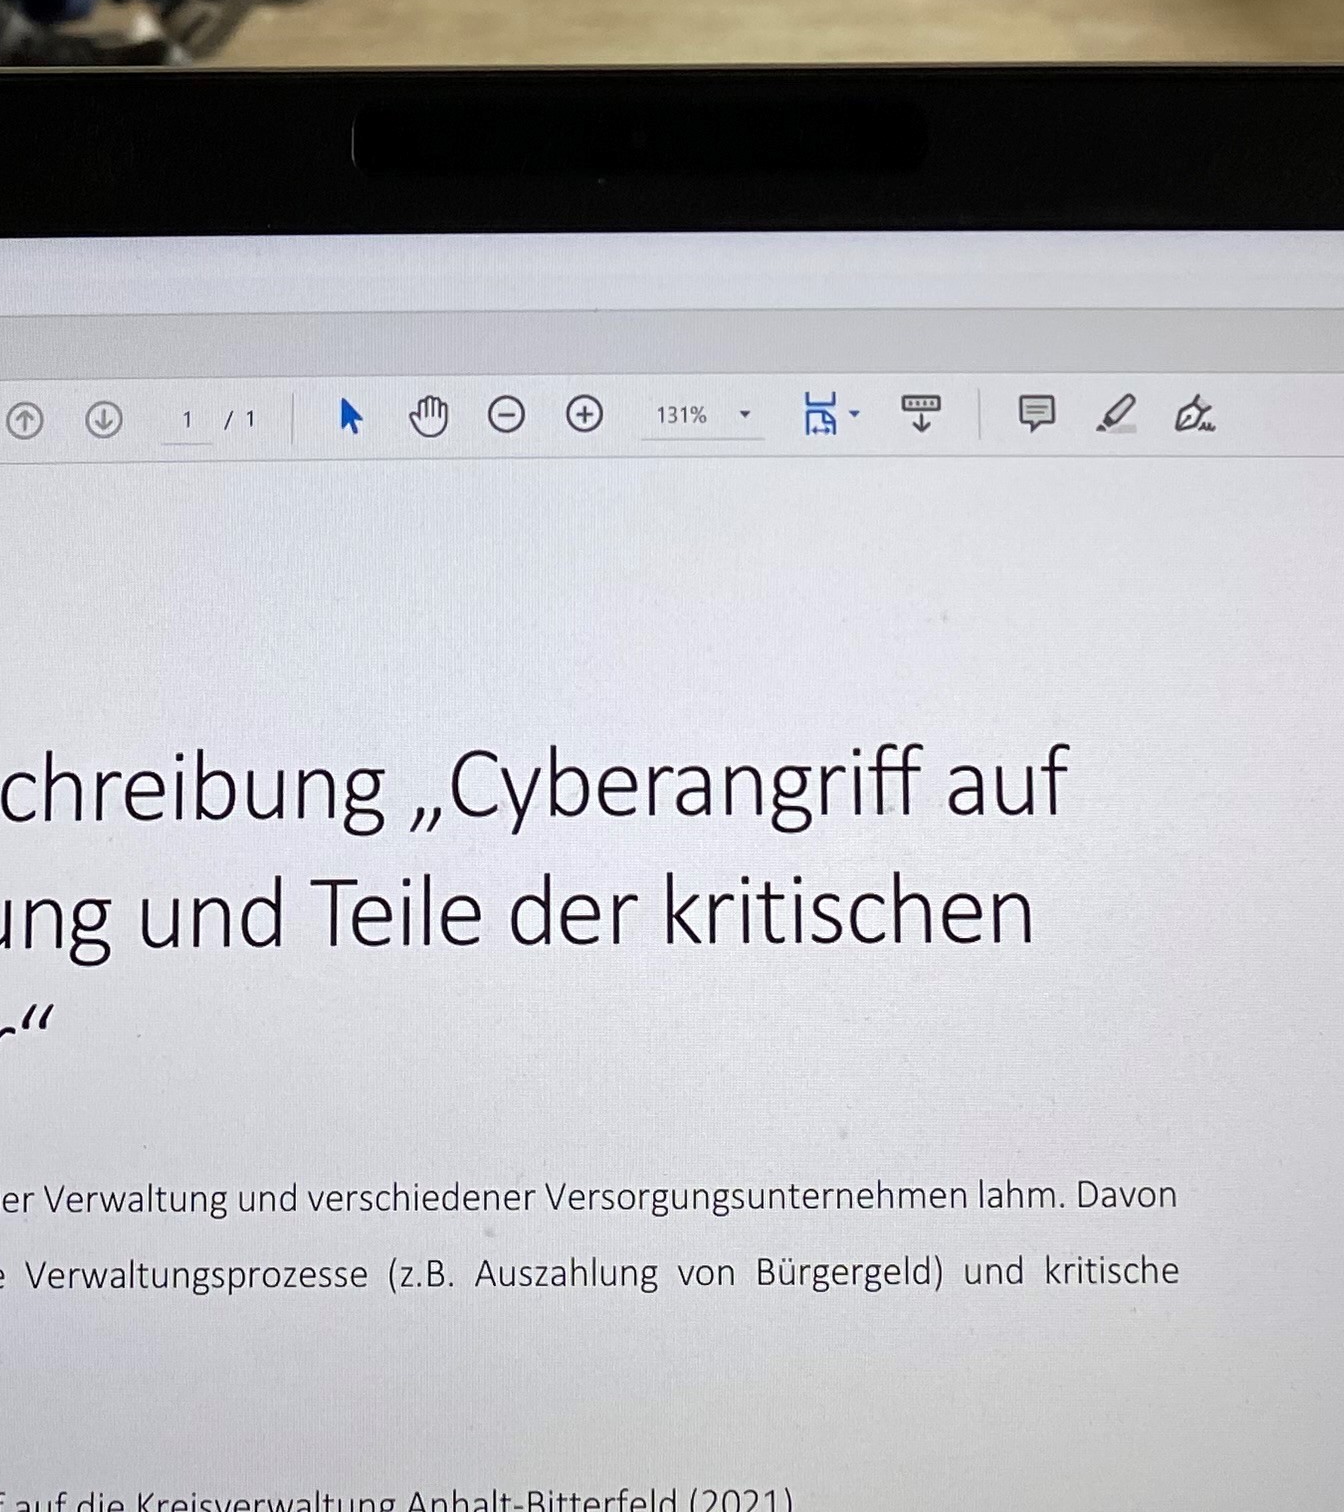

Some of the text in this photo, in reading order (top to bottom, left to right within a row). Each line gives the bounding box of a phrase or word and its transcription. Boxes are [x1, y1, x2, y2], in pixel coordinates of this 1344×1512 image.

[183, 409, 254, 431] 1 / 1
[657, 405, 707, 424] 131%
[948, 743, 1071, 816] auf
[141, 874, 282, 949] und
[309, 873, 482, 947] Teile
[510, 872, 639, 946] der
[666, 870, 1032, 945] kritischen
[43, 1182, 228, 1220] Verwaltung
[239, 1182, 297, 1213] und
[307, 1181, 537, 1212] verschiedener
[544, 1178, 967, 1218] Versorgungsunternehmen
[979, 1178, 1065, 1209] lahm.
[1078, 1180, 1177, 1208] Davon
[25, 1258, 368, 1296] Verwaltungsprozesse
[389, 1257, 454, 1294] (z.B.
[474, 1256, 658, 1294] Auszahlung
[677, 1264, 735, 1286] von
[757, 1254, 943, 1293] Bürgergeld)
[964, 1254, 1023, 1285] und
[1045, 1253, 1179, 1285] kritische
[76, 1490, 126, 1512] die
